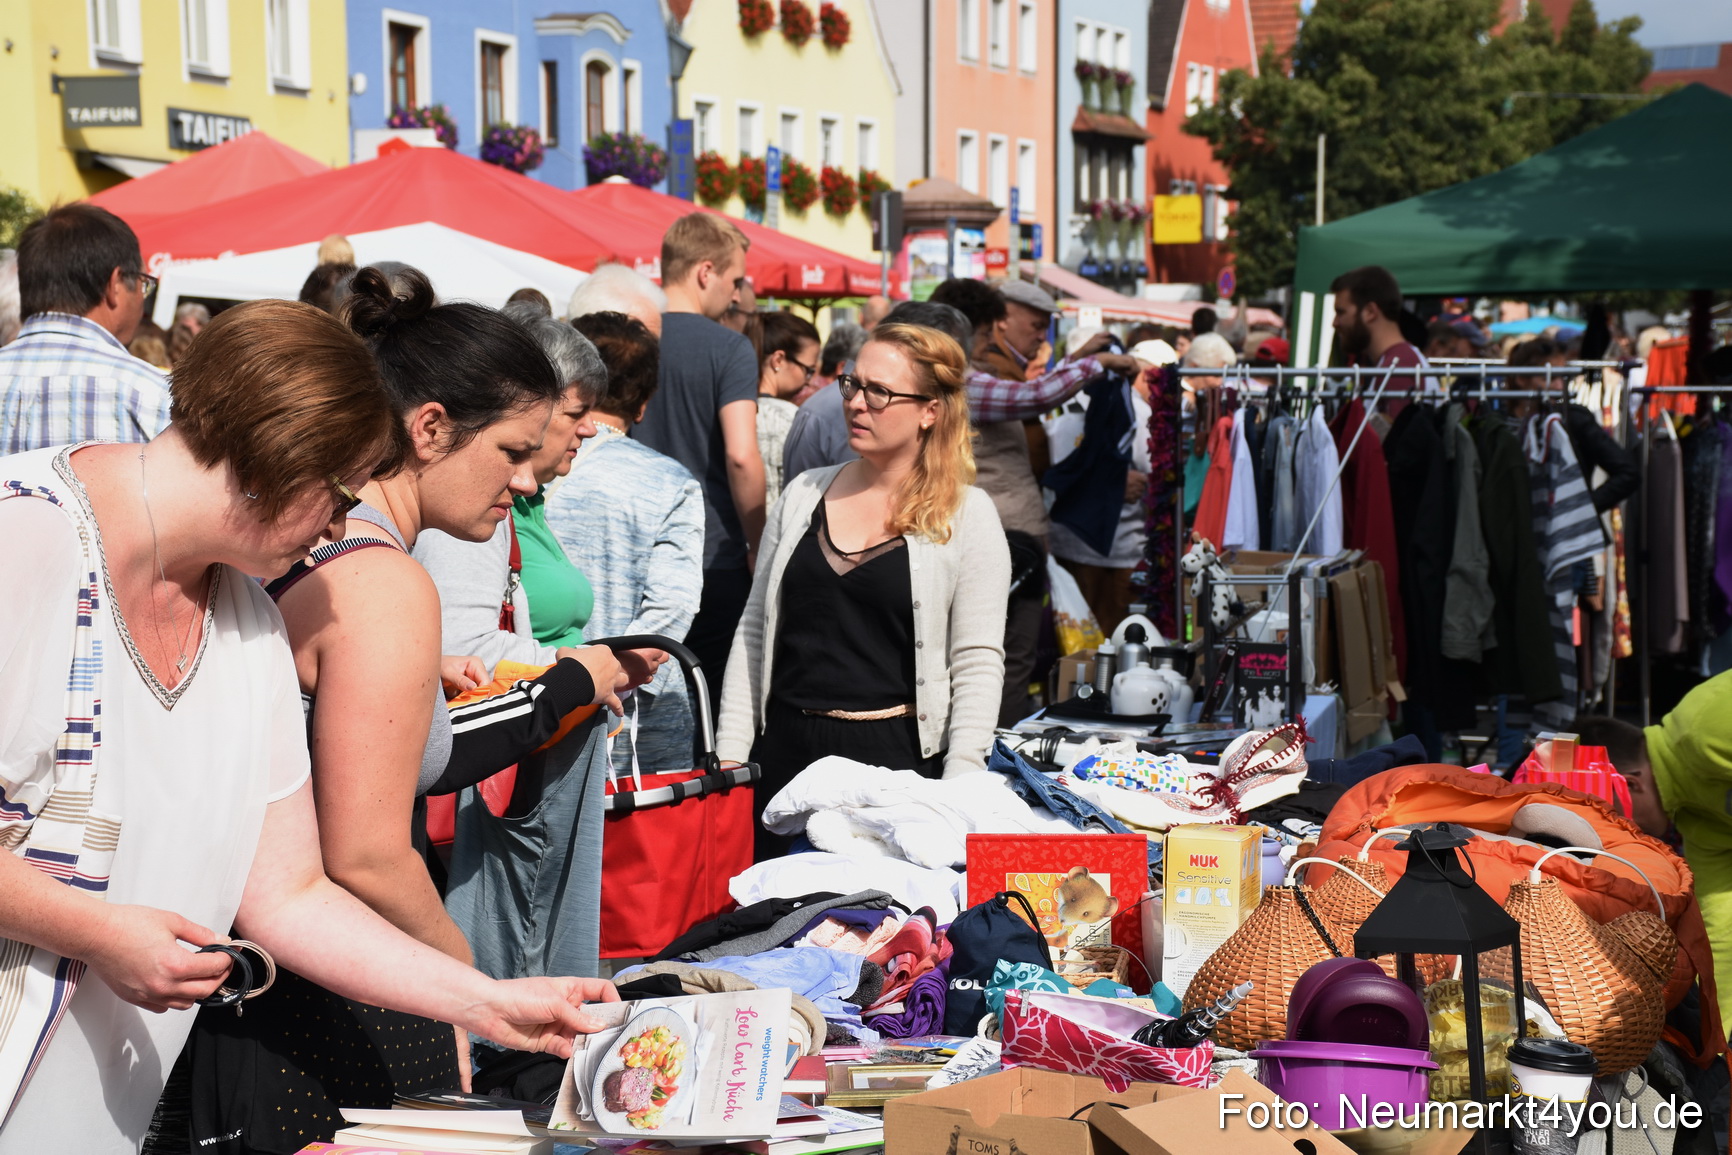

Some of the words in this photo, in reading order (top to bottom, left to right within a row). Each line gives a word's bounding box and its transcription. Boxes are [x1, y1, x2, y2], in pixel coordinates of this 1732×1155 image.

[68, 106, 138, 122] TAIFUN
[178, 112, 258, 145] TAIFU
[1189, 854, 1219, 868] NUK
[1177, 871, 1232, 885] Sensitive
[735, 1006, 758, 1039] Low
[732, 1042, 752, 1077] Carb
[723, 1080, 746, 1123] Küche
[1524, 1127, 1550, 1137] GUTER
[1524, 1134, 1550, 1146] TAG!
[968, 1139, 1000, 1155] TOMS
